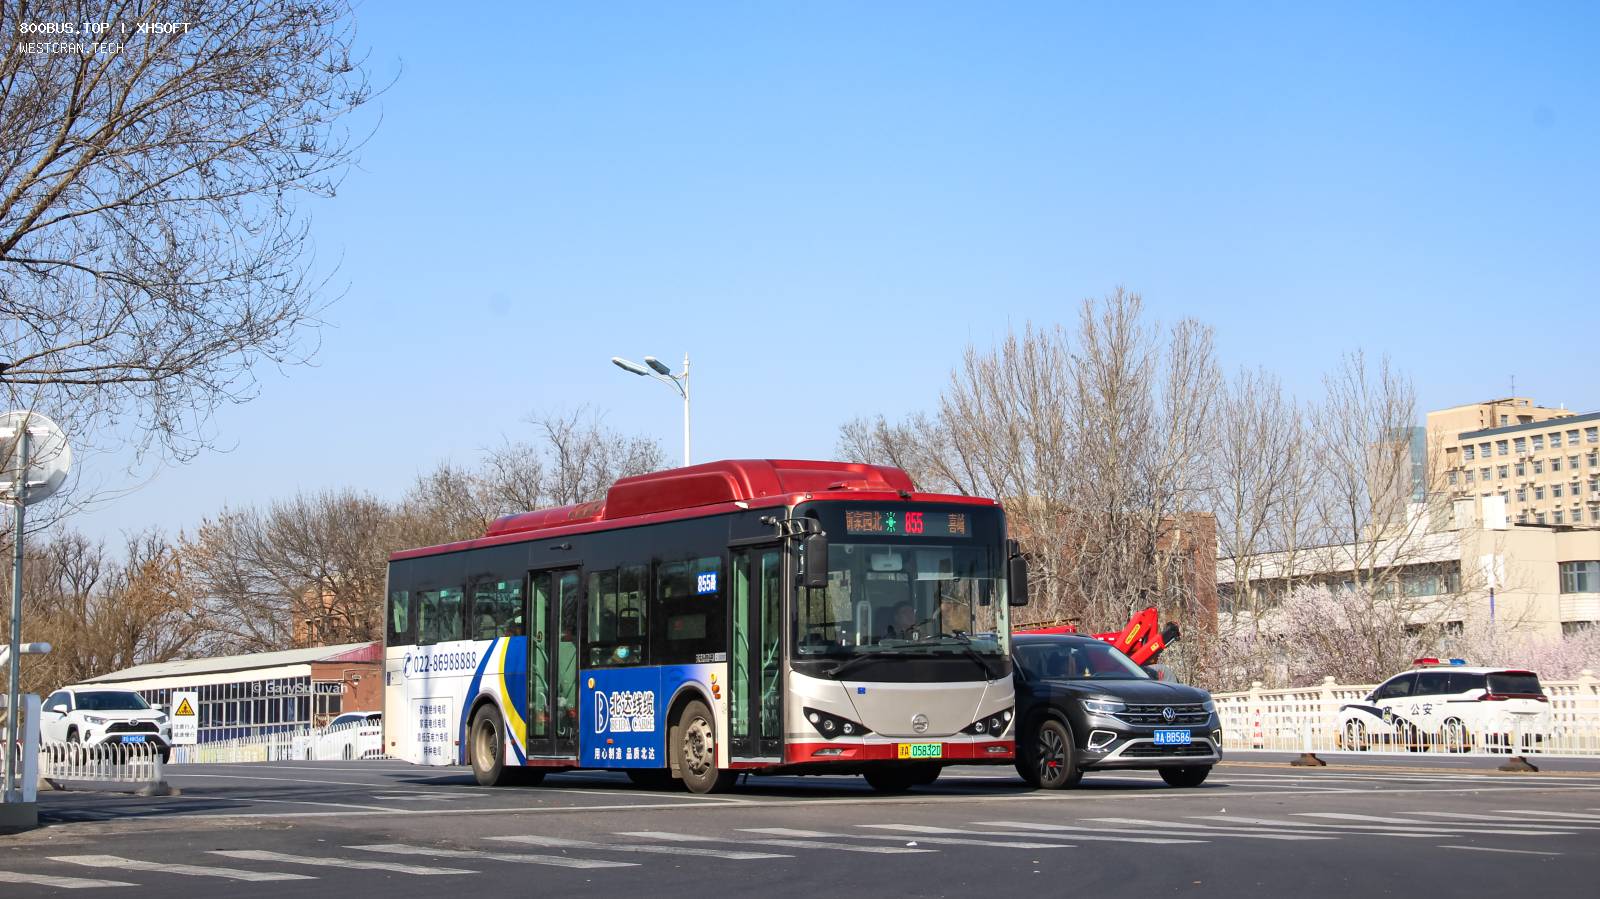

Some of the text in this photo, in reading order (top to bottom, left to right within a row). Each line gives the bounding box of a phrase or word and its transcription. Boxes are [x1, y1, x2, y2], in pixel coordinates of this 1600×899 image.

[905, 511, 924, 534] 855
[697, 574, 716, 593] 855路
[414, 651, 477, 673] 022-86988888
[609, 691, 655, 717] 北达线缆
[1410, 703, 1433, 716] 公安
[594, 747, 655, 760] 用心制造 品质北达
